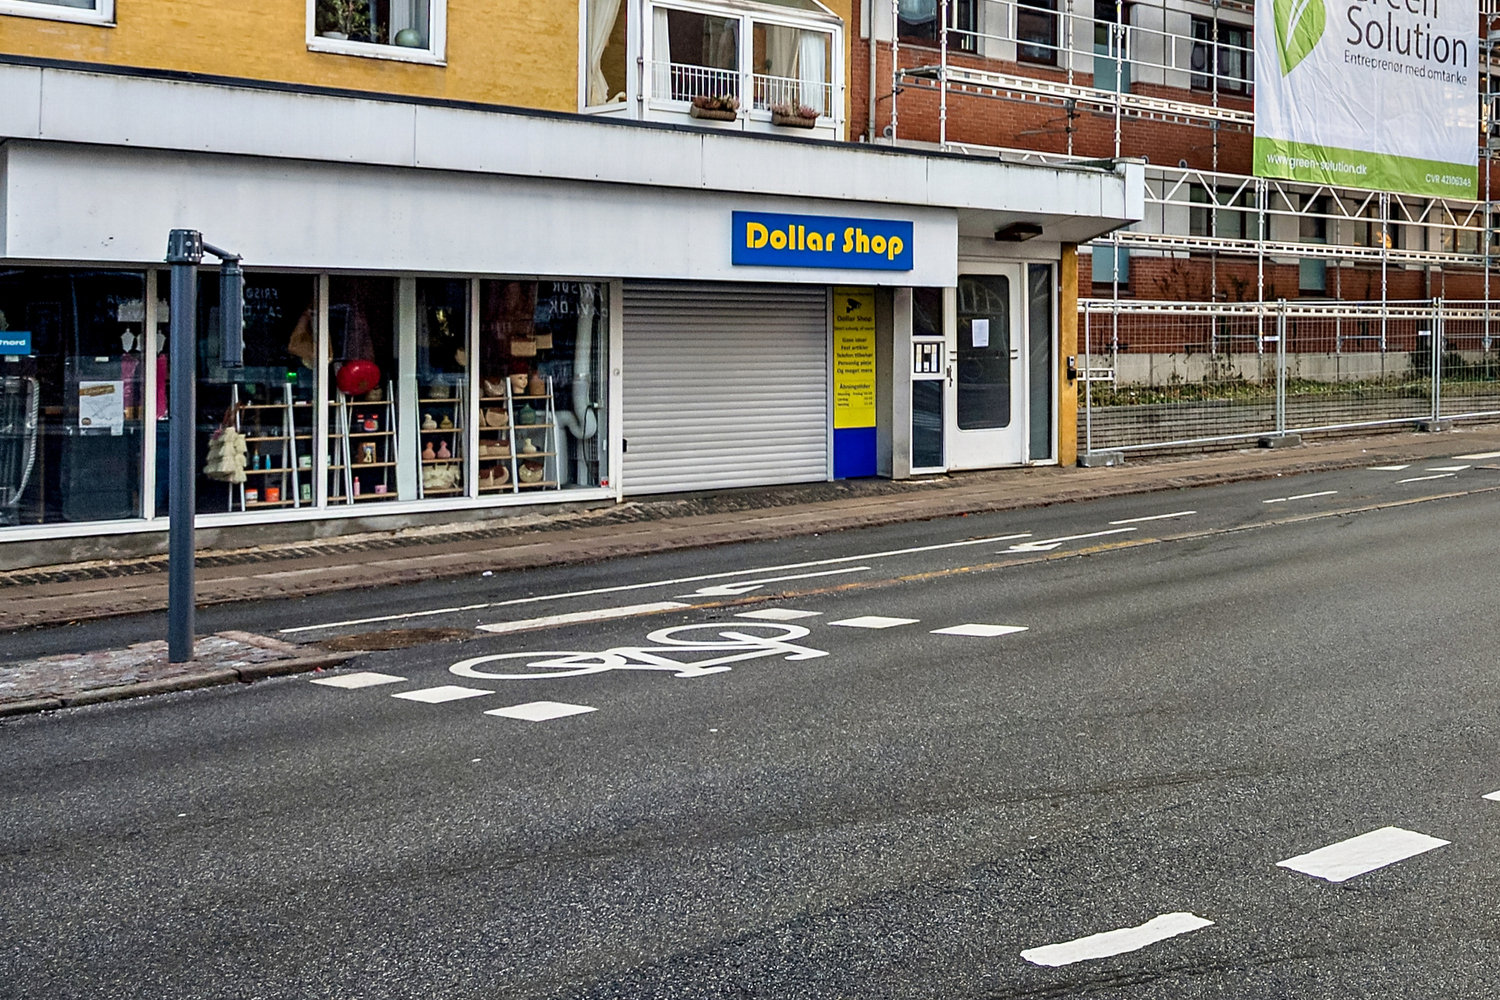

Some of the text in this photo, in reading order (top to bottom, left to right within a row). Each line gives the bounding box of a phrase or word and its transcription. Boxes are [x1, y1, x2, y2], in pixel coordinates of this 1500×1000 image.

[1346, 5, 1468, 68] Solution
[1344, 50, 1467, 86] Entreprenør med omtanke
[1425, 173, 1441, 184] CVR
[746, 222, 904, 261] Dollar Shop
[856, 315, 872, 323] Shop
